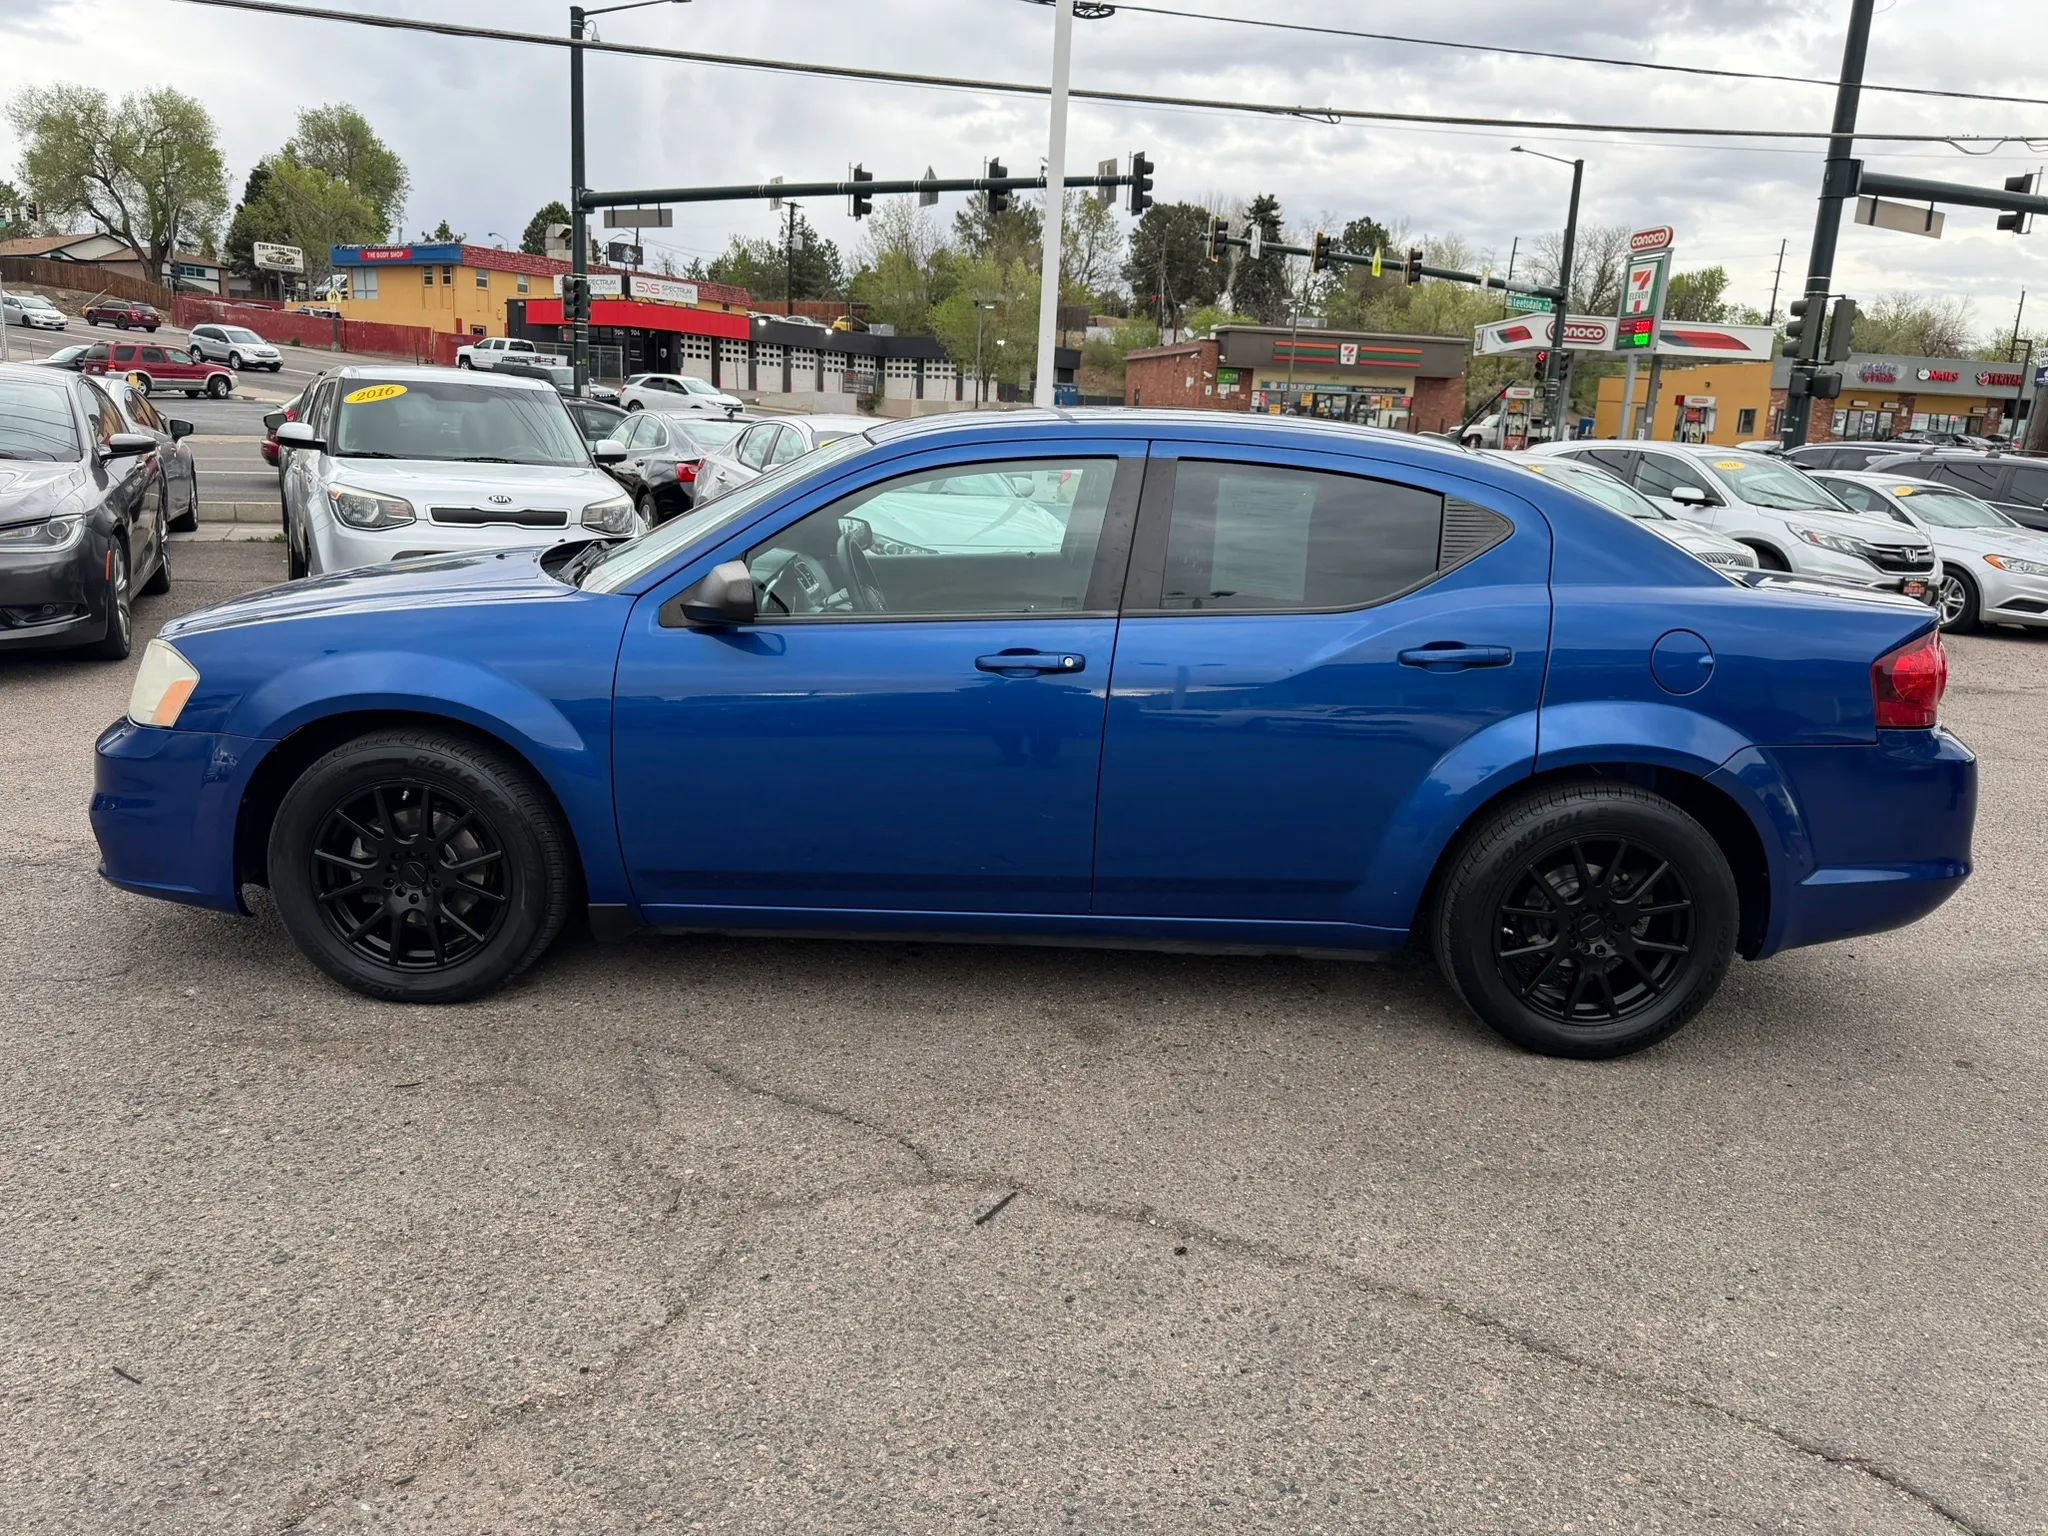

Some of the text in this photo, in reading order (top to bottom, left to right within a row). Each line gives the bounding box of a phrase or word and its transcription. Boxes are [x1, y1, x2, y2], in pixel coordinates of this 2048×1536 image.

[390, 250, 404, 258] SHOP
[1629, 290, 1649, 301] ELEVEN
[1513, 297, 1543, 310] Leetsdale
[356, 386, 395, 401] 2016
